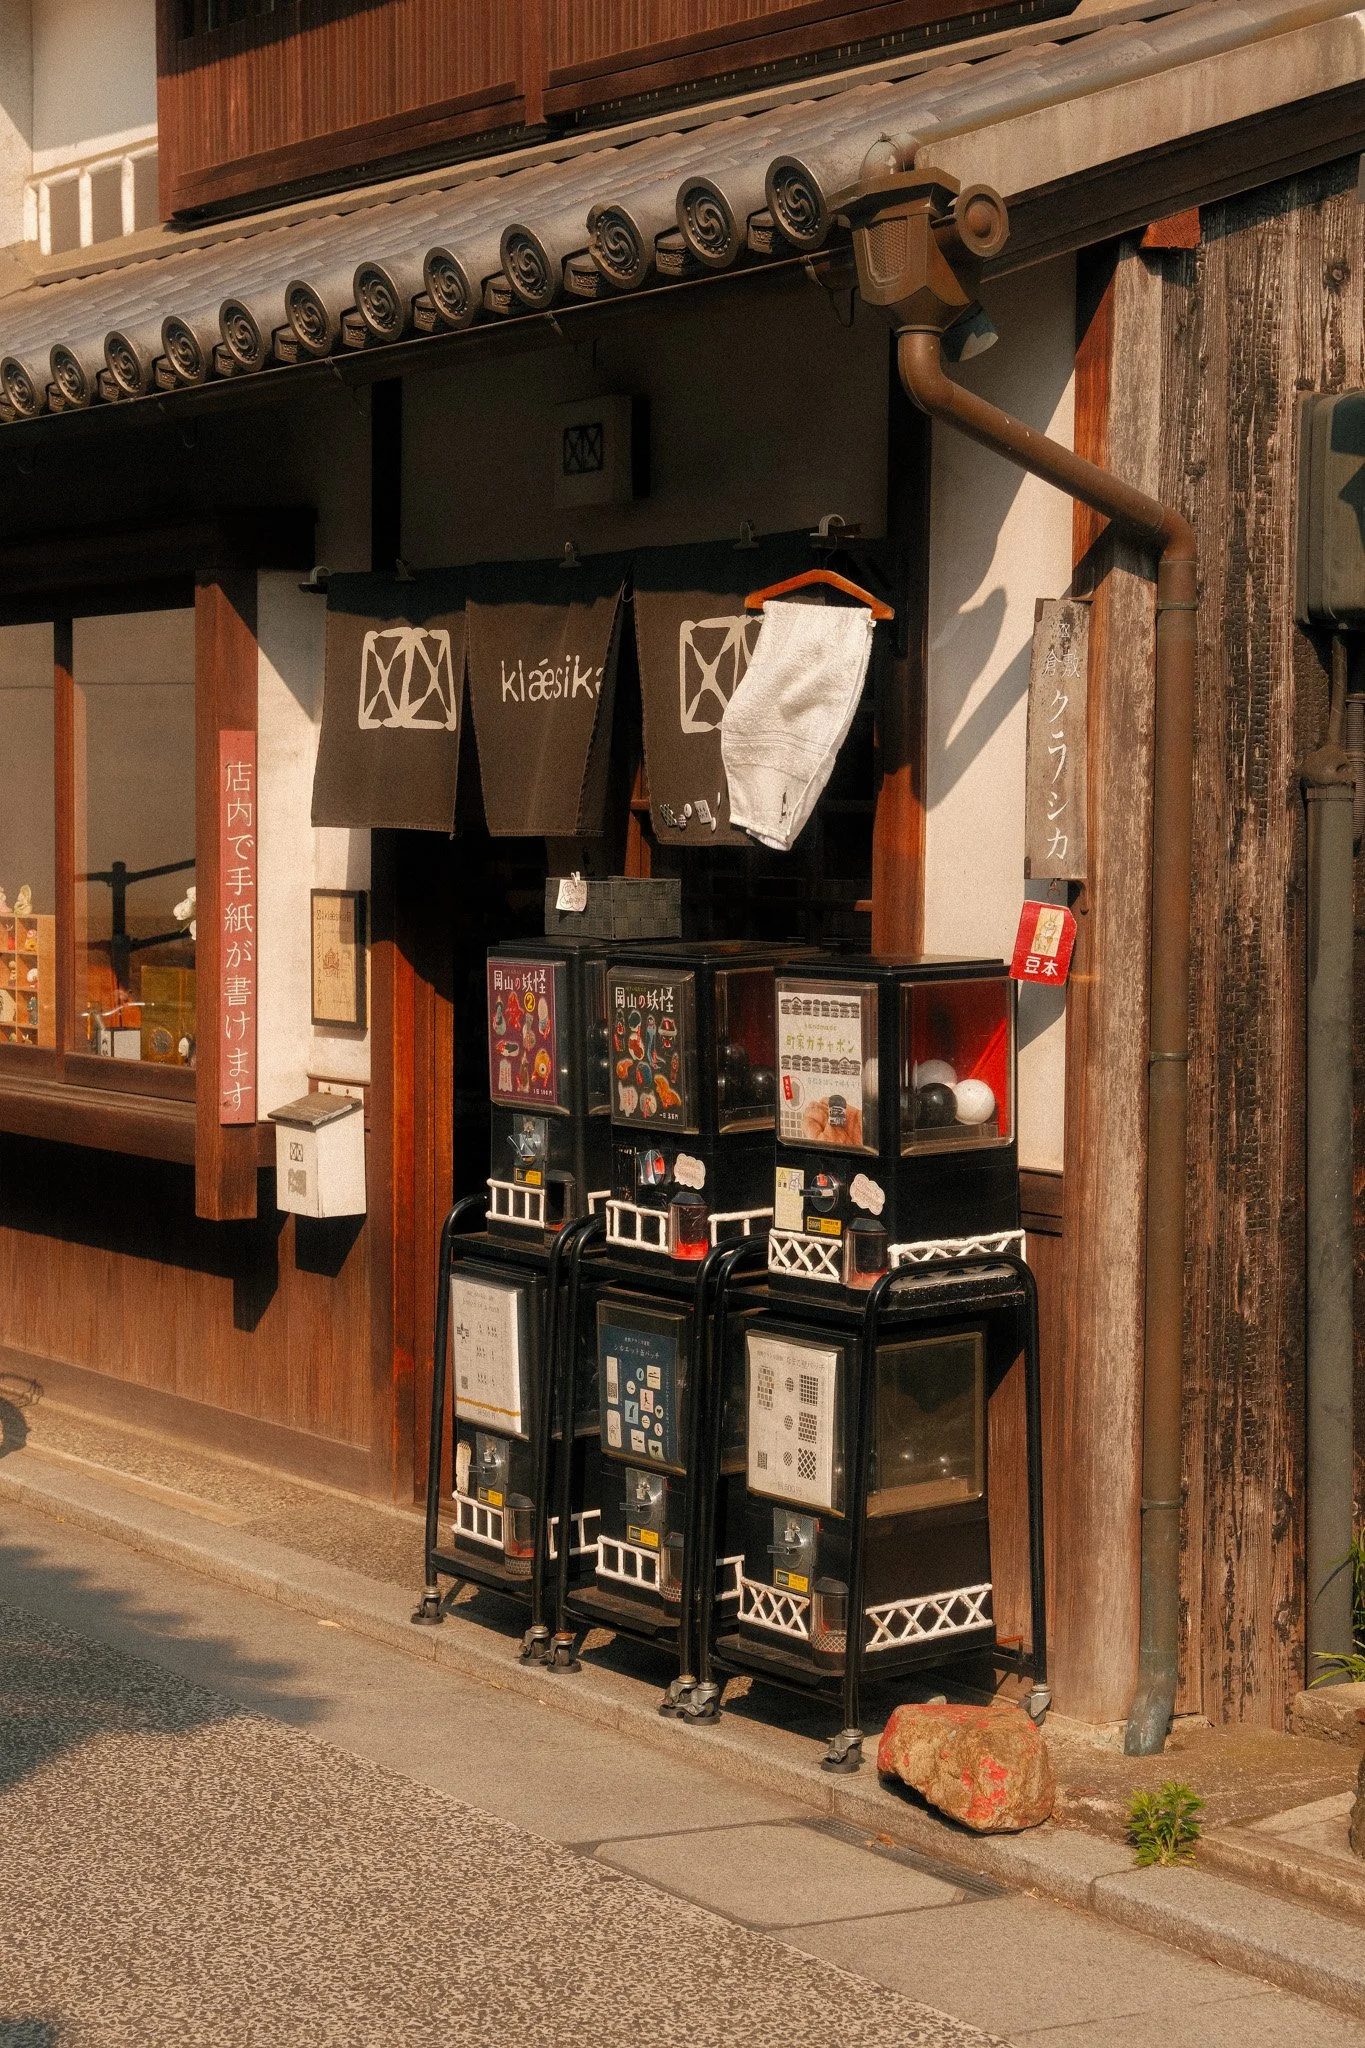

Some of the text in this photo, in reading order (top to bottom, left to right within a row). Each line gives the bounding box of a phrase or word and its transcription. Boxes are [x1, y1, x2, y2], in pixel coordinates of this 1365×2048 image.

[1043, 648, 1080, 678] 倉敷
[1046, 689, 1070, 861] クラシカ
[223, 761, 255, 1112] 店内で手紙が書けます
[493, 968, 546, 994] 岡山の妖怪
[1024, 955, 1058, 978] 豆本
[615, 986, 674, 1014] 岡山の妖怪
